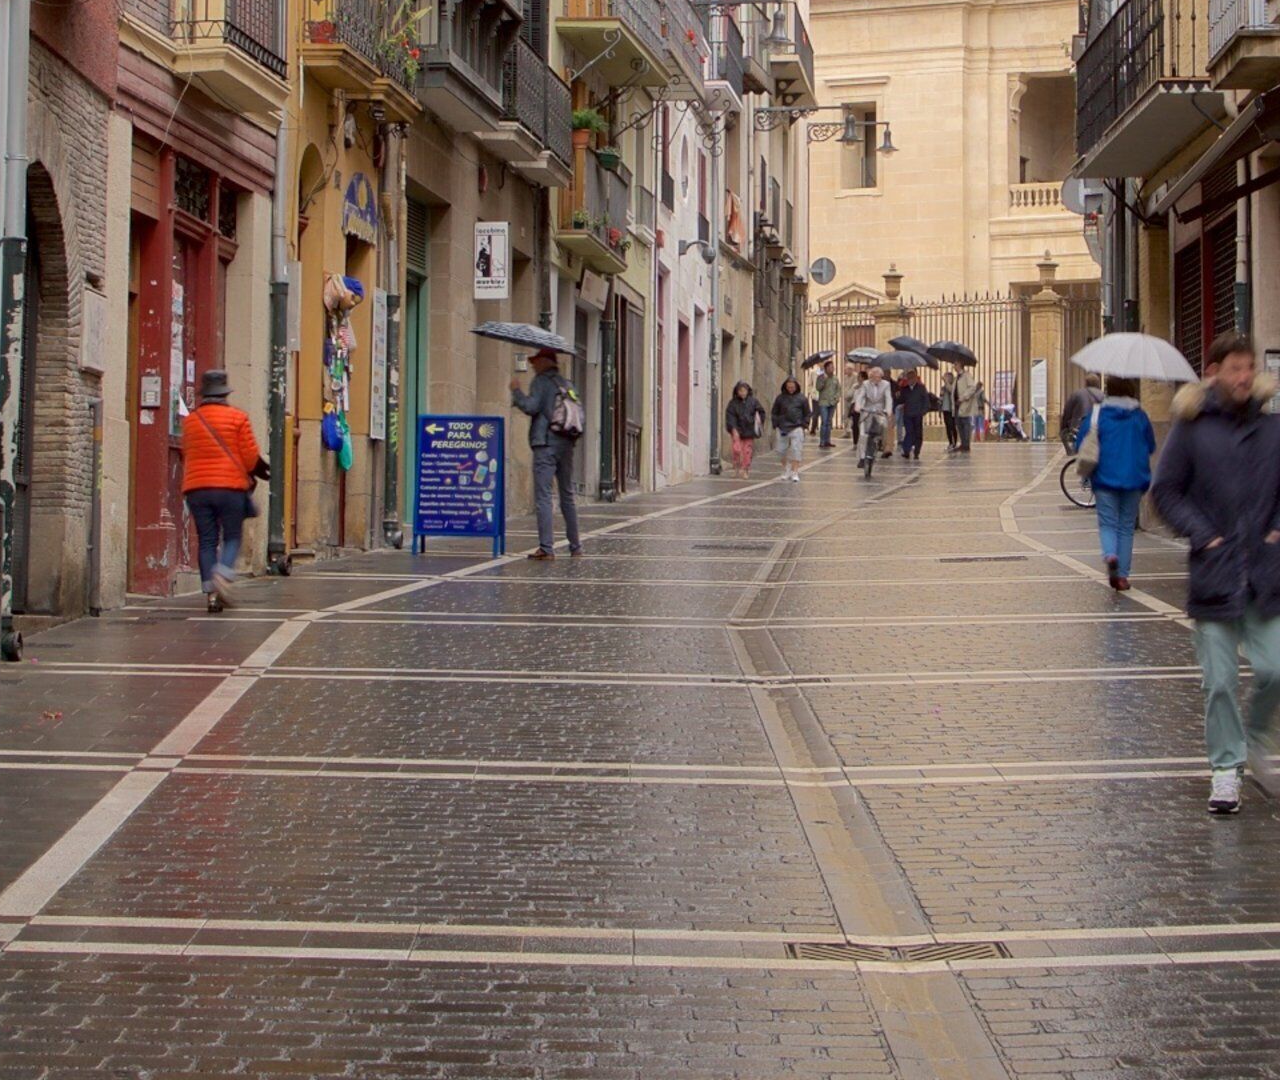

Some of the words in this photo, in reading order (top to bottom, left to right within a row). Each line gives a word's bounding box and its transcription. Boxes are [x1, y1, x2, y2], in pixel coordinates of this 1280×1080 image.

[448, 422, 473, 431] TODO
[447, 431, 472, 439] PARA
[431, 440, 488, 449] PEREGRINOS
